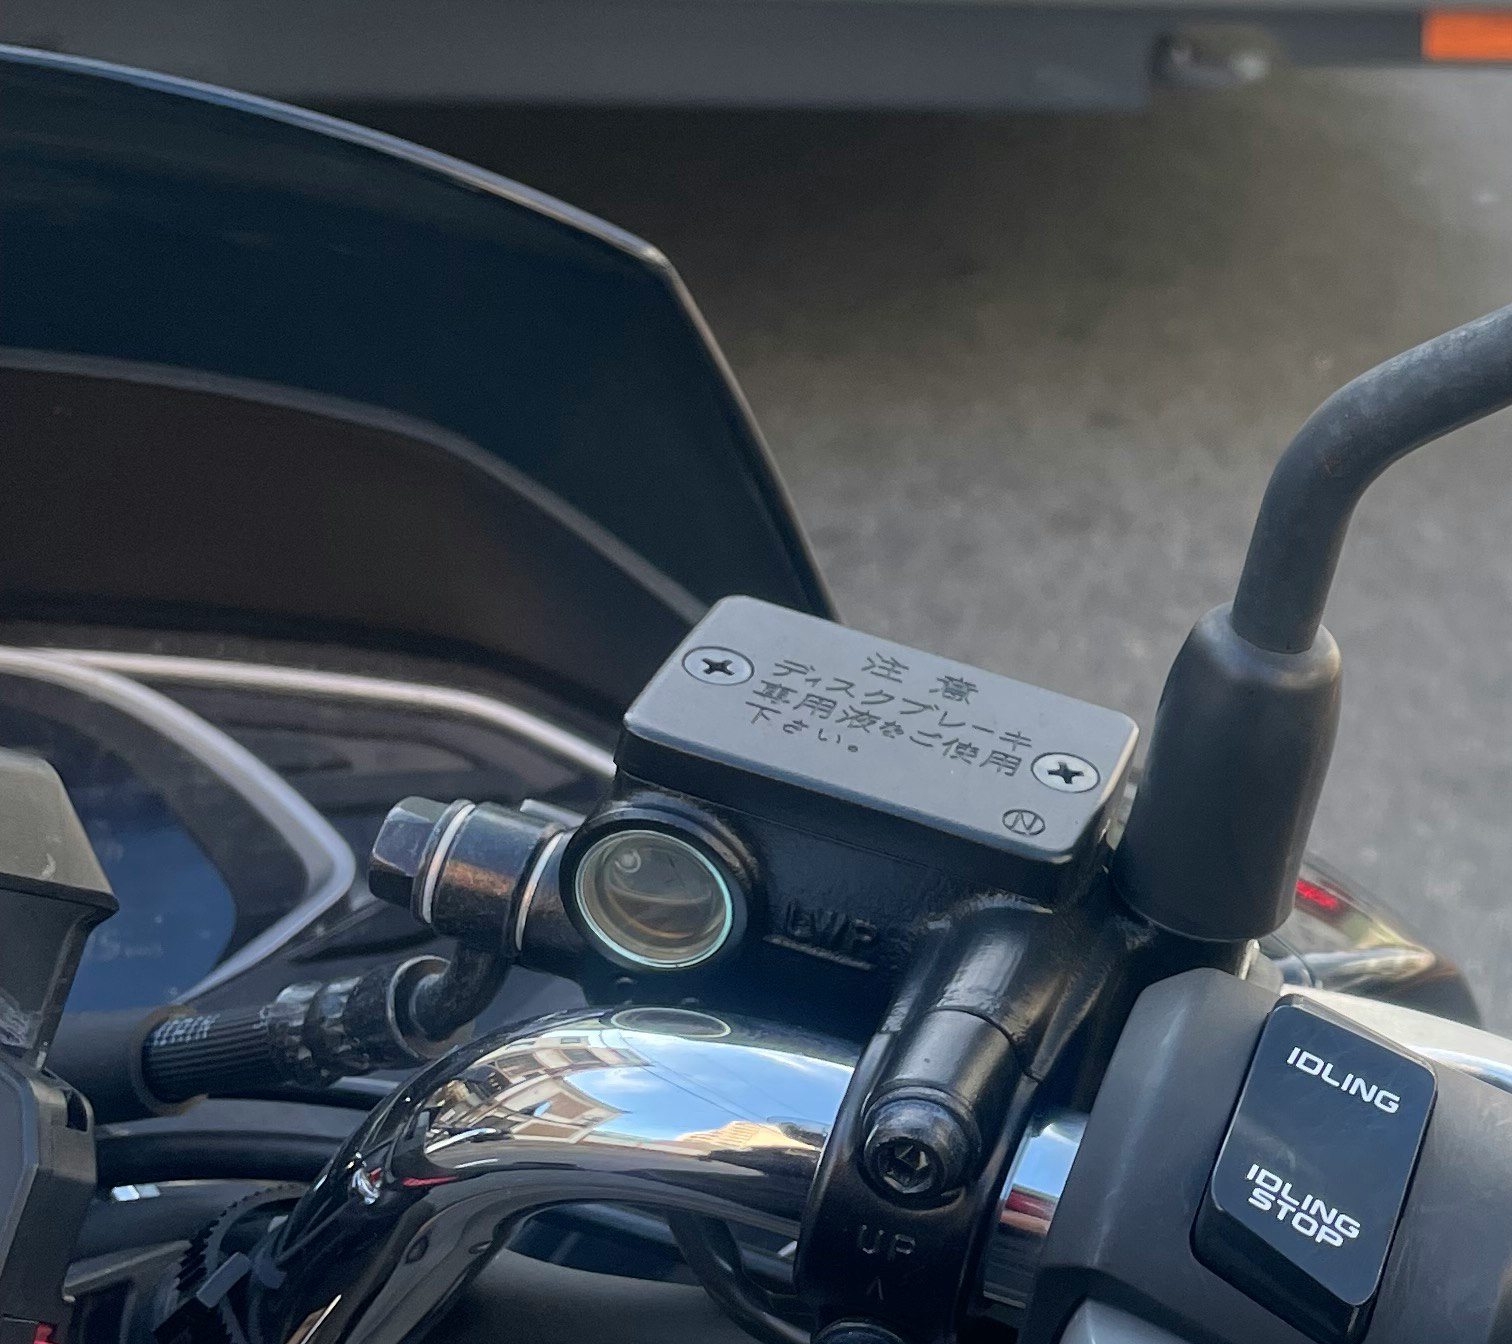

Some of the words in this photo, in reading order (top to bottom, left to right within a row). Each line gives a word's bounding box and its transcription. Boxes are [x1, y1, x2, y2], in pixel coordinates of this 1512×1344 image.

[744, 700, 860, 754] 下さい。
[752, 678, 1023, 777] 専用液をご使用
[771, 658, 1033, 751] ディスクブレーキ
[1286, 1046, 1401, 1115] IDLING
[1246, 1163, 1361, 1239] IDLING
[1247, 1187, 1345, 1248] STOP
[858, 1223, 917, 1262] UP
